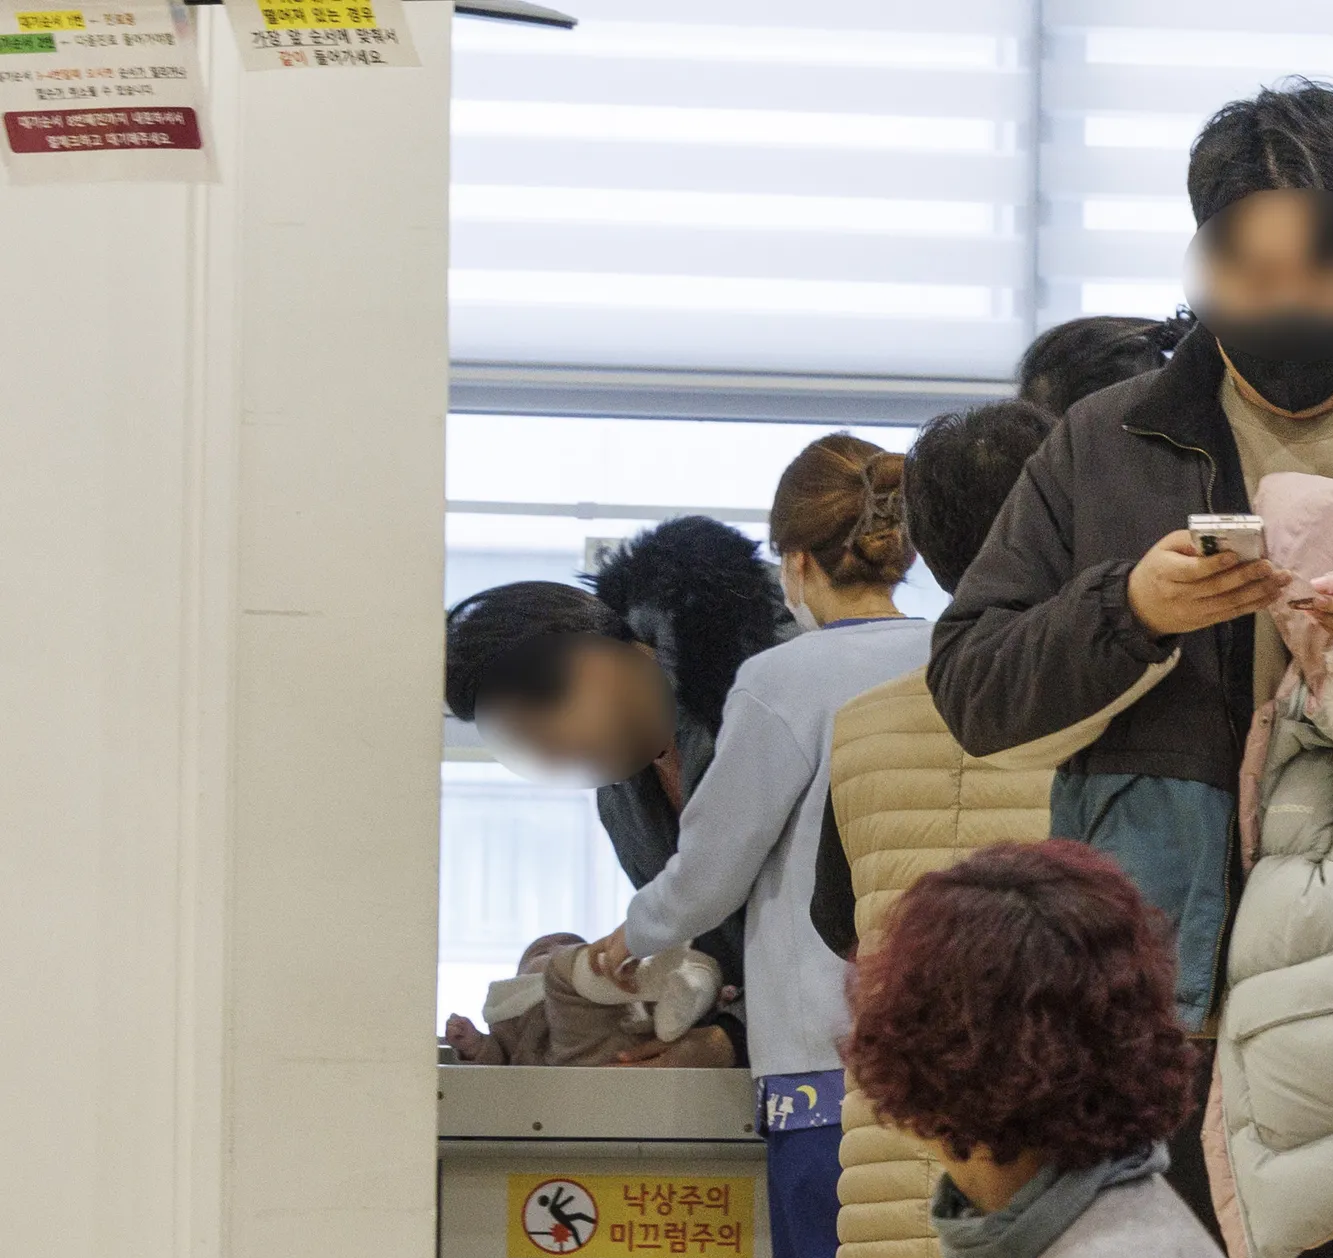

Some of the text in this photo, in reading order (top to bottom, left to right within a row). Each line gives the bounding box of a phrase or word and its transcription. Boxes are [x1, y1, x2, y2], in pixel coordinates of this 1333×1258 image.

[262, 6, 376, 25] 떨어져 있는 경우
[251, 28, 399, 47] 가장 앞 순서에 맞춰서
[278, 49, 389, 67] 같이 들어가세요
[622, 1182, 731, 1217] 낙상주의
[609, 1219, 742, 1254] 미끄럼주의
